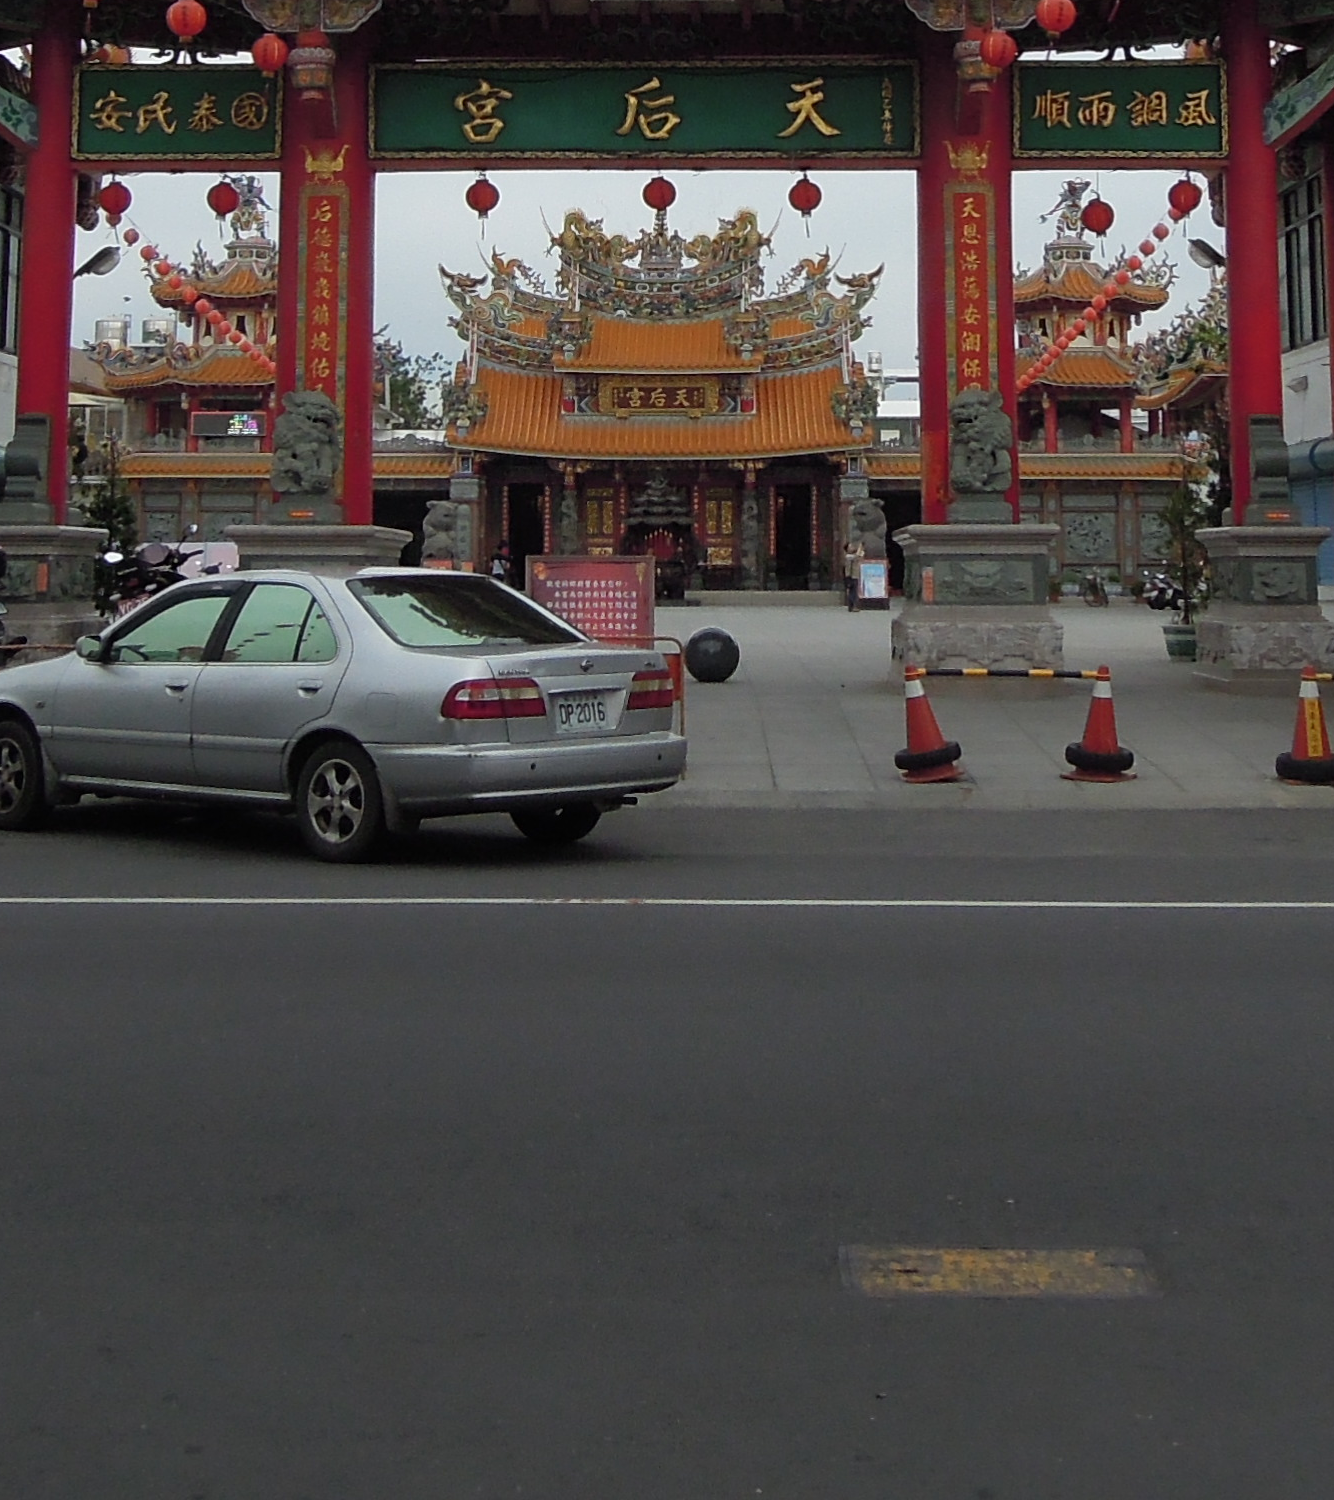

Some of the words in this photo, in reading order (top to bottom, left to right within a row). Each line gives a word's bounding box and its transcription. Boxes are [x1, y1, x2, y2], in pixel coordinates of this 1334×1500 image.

[89, 90, 269, 134] 國泰民安
[454, 77, 842, 143] 天后宮
[1031, 89, 1216, 128] 風調雨順
[626, 388, 690, 408] 天后宮
